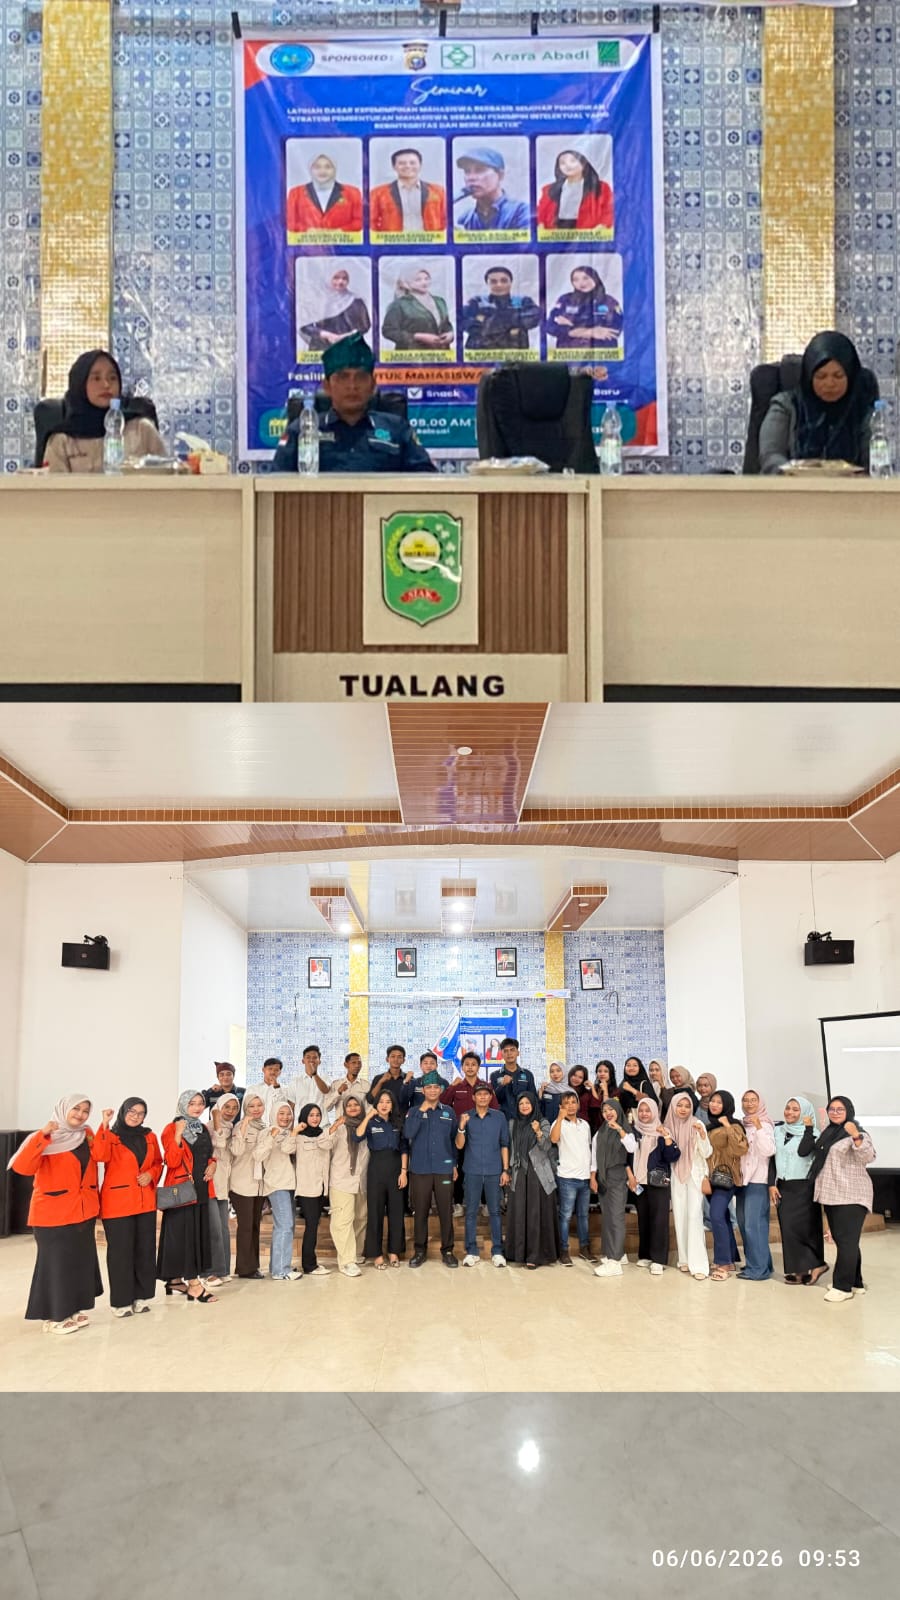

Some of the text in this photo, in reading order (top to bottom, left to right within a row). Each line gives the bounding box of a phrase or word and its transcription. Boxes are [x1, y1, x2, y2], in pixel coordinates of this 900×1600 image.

[492, 48, 590, 62] Arara Abadi
[410, 76, 488, 105] Seminar
[426, 390, 460, 398] Snack
[450, 418, 472, 427] AM
[408, 588, 434, 602] SIAK
[340, 674, 505, 697] TUALANG
